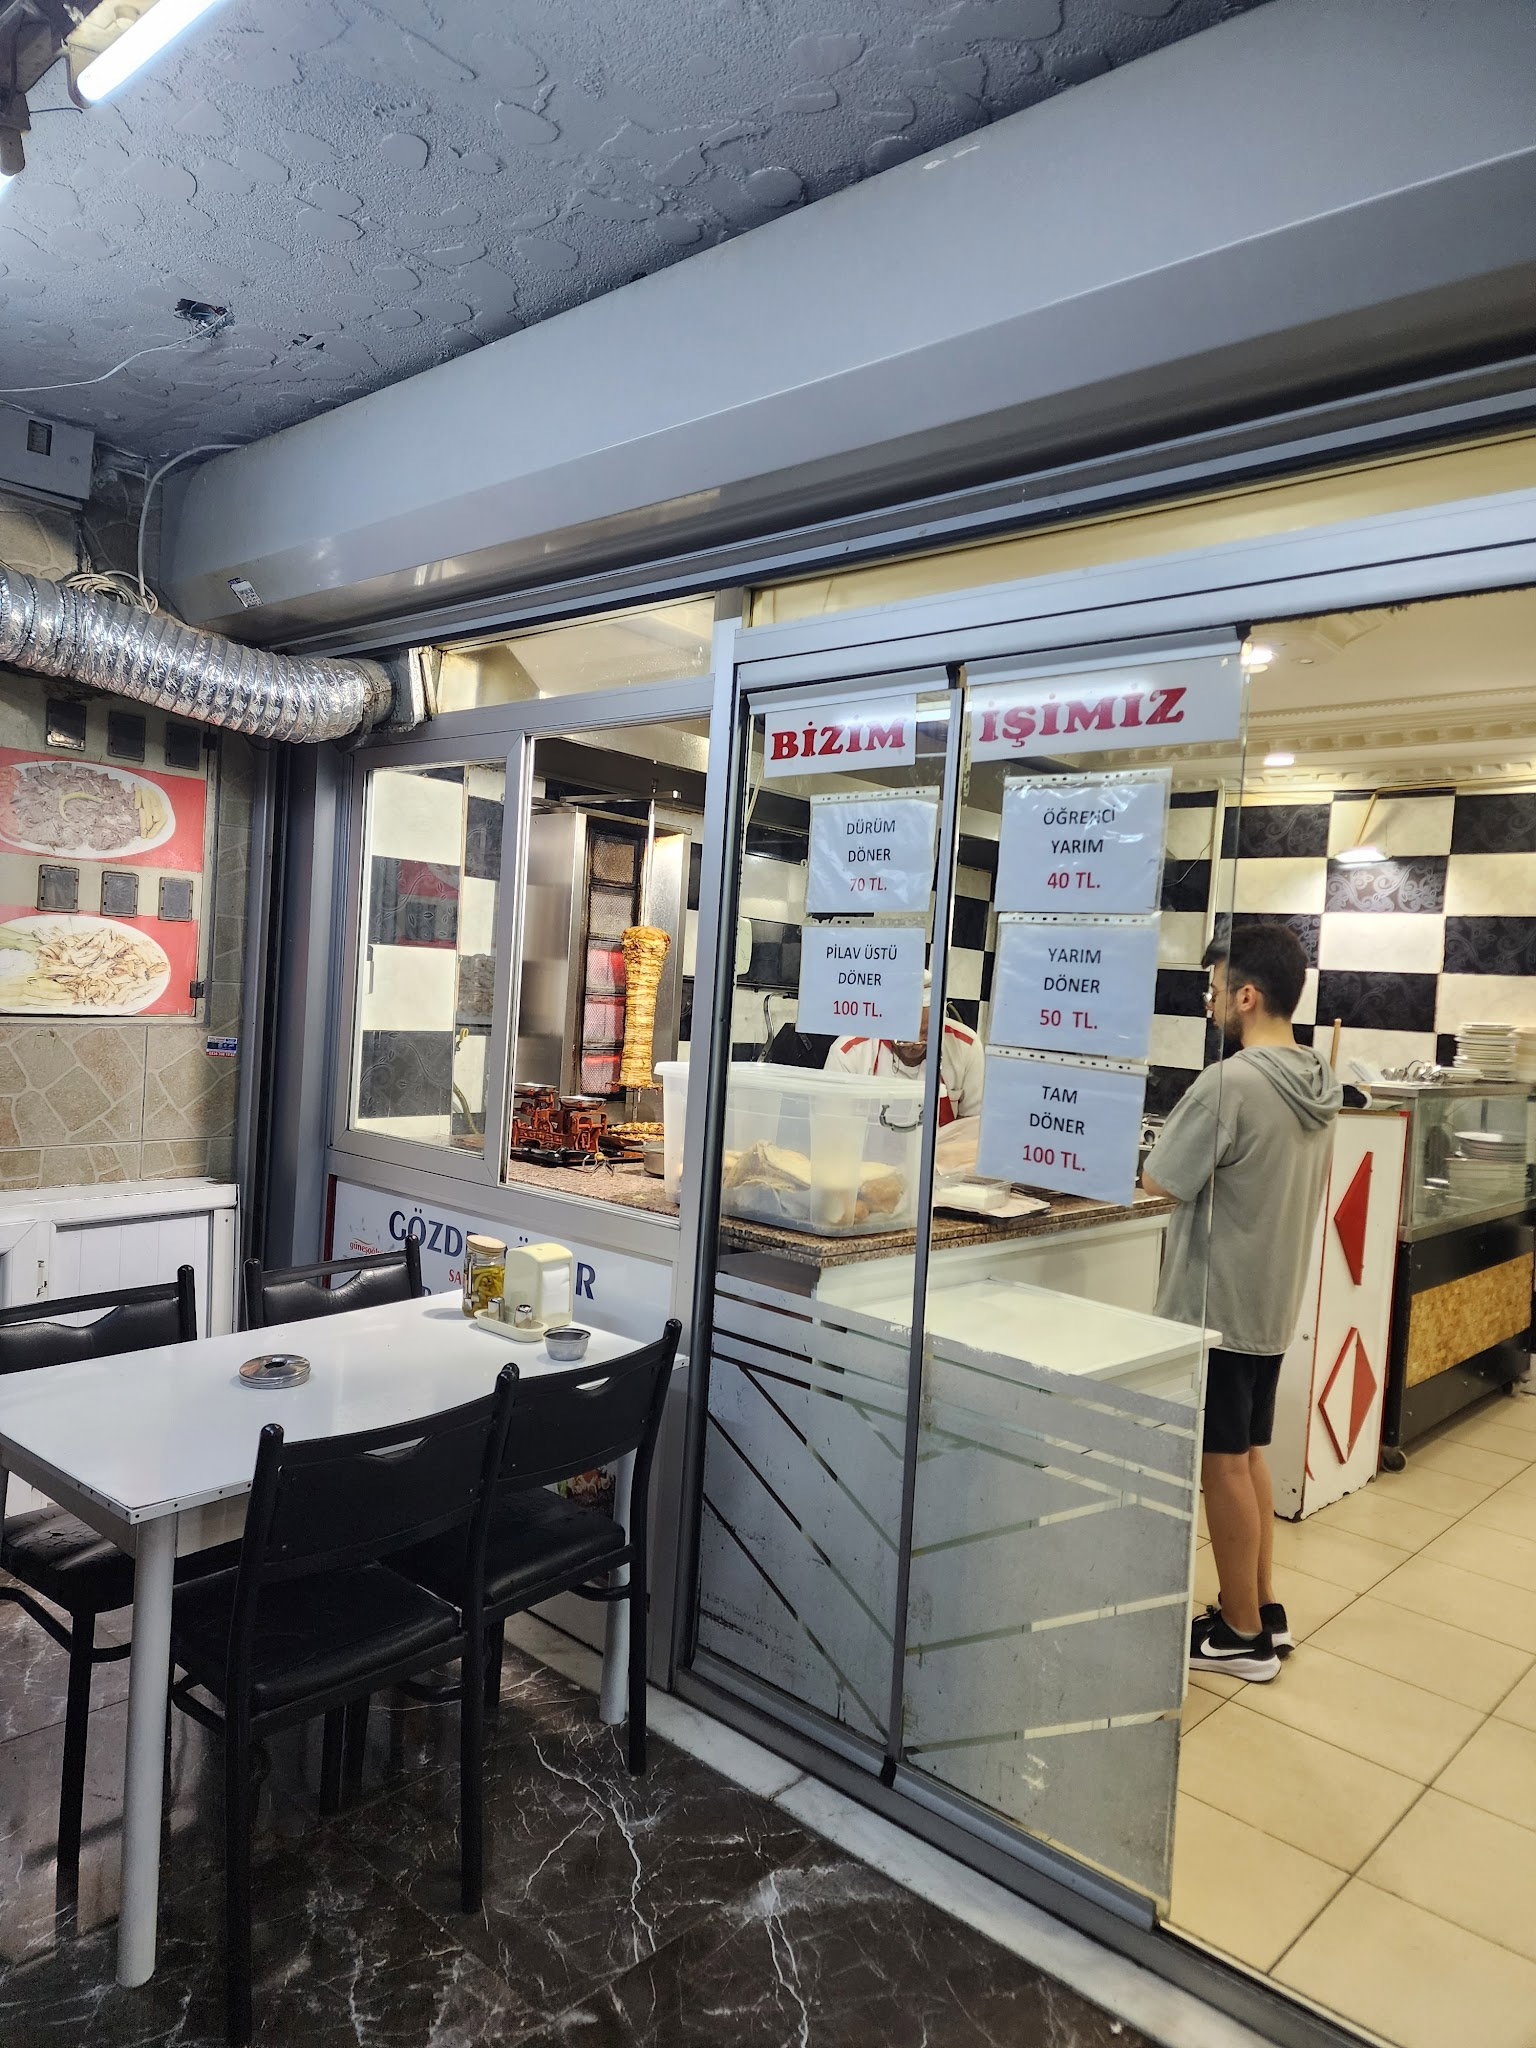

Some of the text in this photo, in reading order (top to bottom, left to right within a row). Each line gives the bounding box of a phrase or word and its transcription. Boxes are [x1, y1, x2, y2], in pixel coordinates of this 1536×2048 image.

[770, 683, 1188, 760] BİZİM İŞİMİZ
[1043, 804, 1116, 825] ÖĞRENCİ
[846, 818, 896, 835] DÜRÜM
[848, 846, 891, 863] DÖNER
[1051, 838, 1104, 854] YARIM
[850, 877, 887, 892] 70 TL.
[1047, 872, 1101, 889] 40 TL.
[826, 944, 897, 961] PİLAV ÜSTÜ
[1048, 948, 1102, 964] YARIM
[838, 969, 882, 986] DÖNER
[1043, 974, 1101, 994] DÖNER
[833, 1000, 882, 1018] 100 TL.
[1039, 1009, 1098, 1030] 50 TL.
[1042, 1085, 1078, 1104] TAM
[1029, 1111, 1085, 1136] DÖNER
[1022, 1144, 1086, 1172] 100 TL.
[388, 1207, 479, 1258] GÖZD
